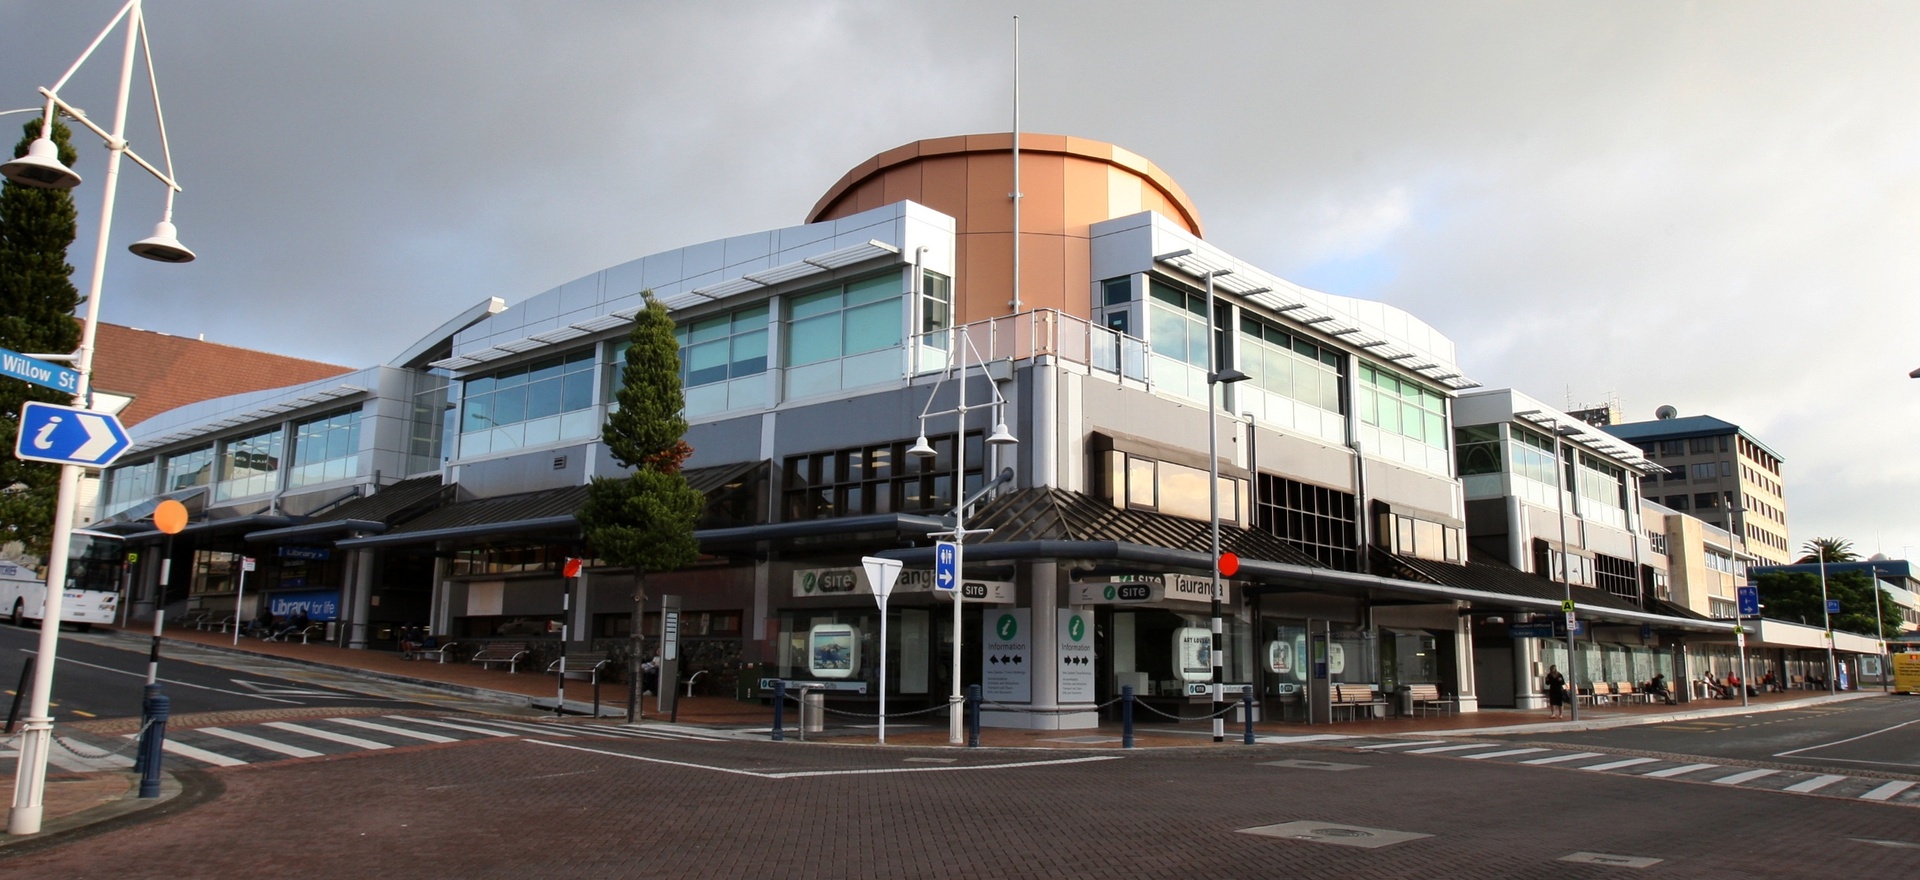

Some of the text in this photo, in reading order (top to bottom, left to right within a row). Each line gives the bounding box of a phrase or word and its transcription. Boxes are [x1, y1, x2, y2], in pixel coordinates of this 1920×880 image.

[3, 354, 76, 390] Willow St
[286, 549, 316, 558] Library
[271, 599, 335, 616] Library for life
[988, 643, 1026, 651] Information
[1062, 643, 1091, 652] Information
